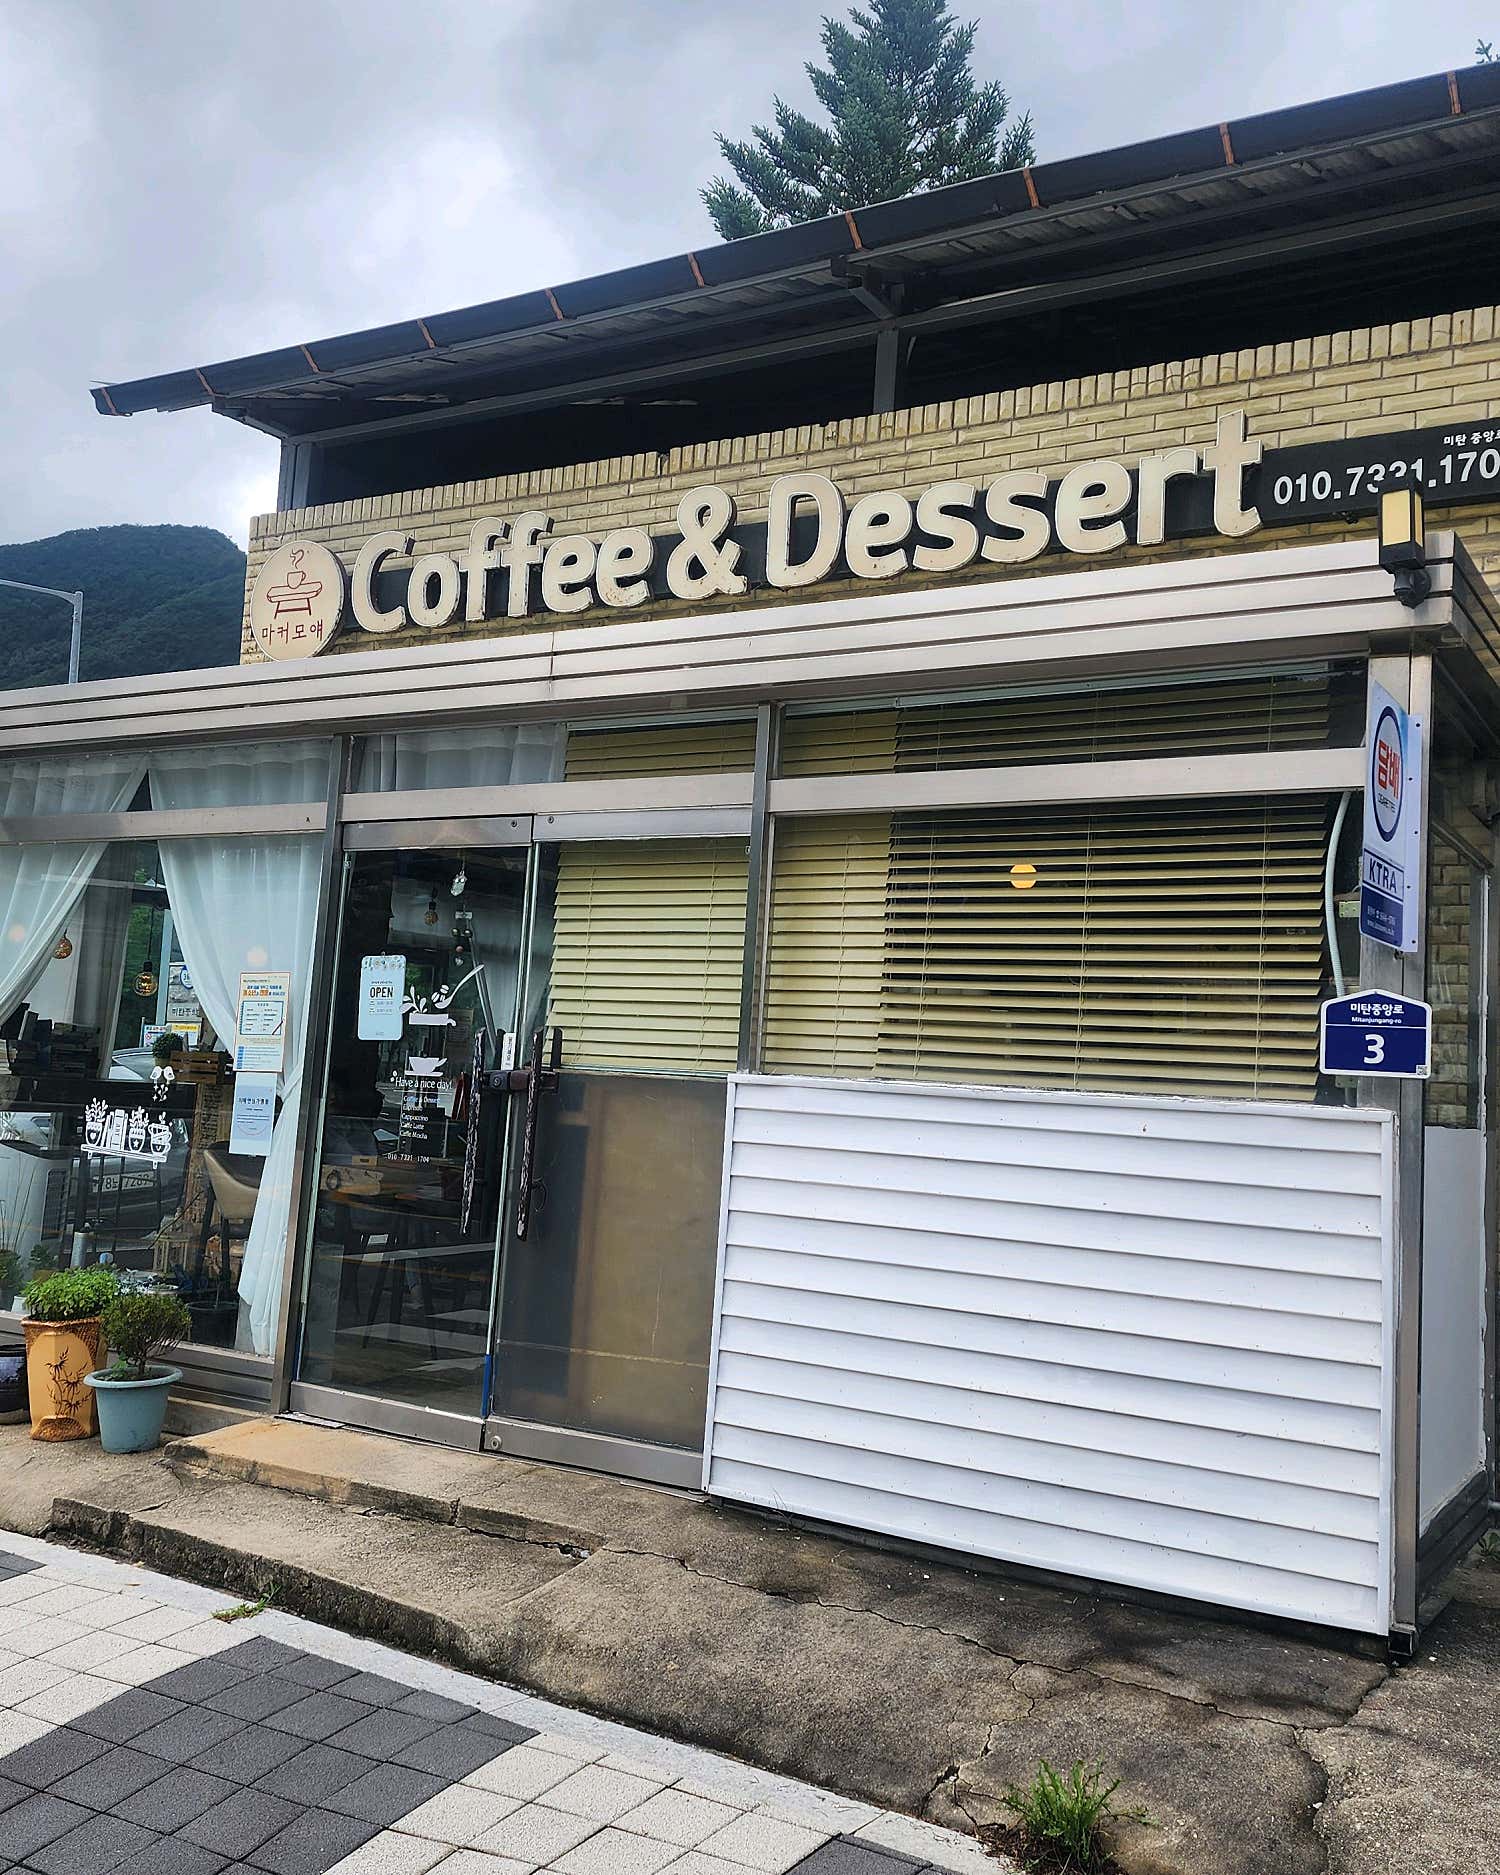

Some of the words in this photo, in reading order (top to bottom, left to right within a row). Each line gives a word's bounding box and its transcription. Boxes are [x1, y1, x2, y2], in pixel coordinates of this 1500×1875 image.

[1443, 434, 1467, 447] 미탄
[352, 511, 654, 633] Coffee
[667, 485, 749, 600] &
[766, 410, 1262, 588] Dessert
[1377, 739, 1400, 800] 담배
[1369, 857, 1397, 894] KTRA
[369, 986, 394, 998] OPEN
[1350, 1002, 1405, 1017] 미탄중앙로
[1351, 1016, 1402, 1025] Mitanjungang-ro
[1363, 1033, 1385, 1065] 3
[395, 1076, 413, 1088] Have
[414, 1079, 419, 1088] a
[420, 1079, 436, 1089] nice
[436, 1079, 453, 1091] day!
